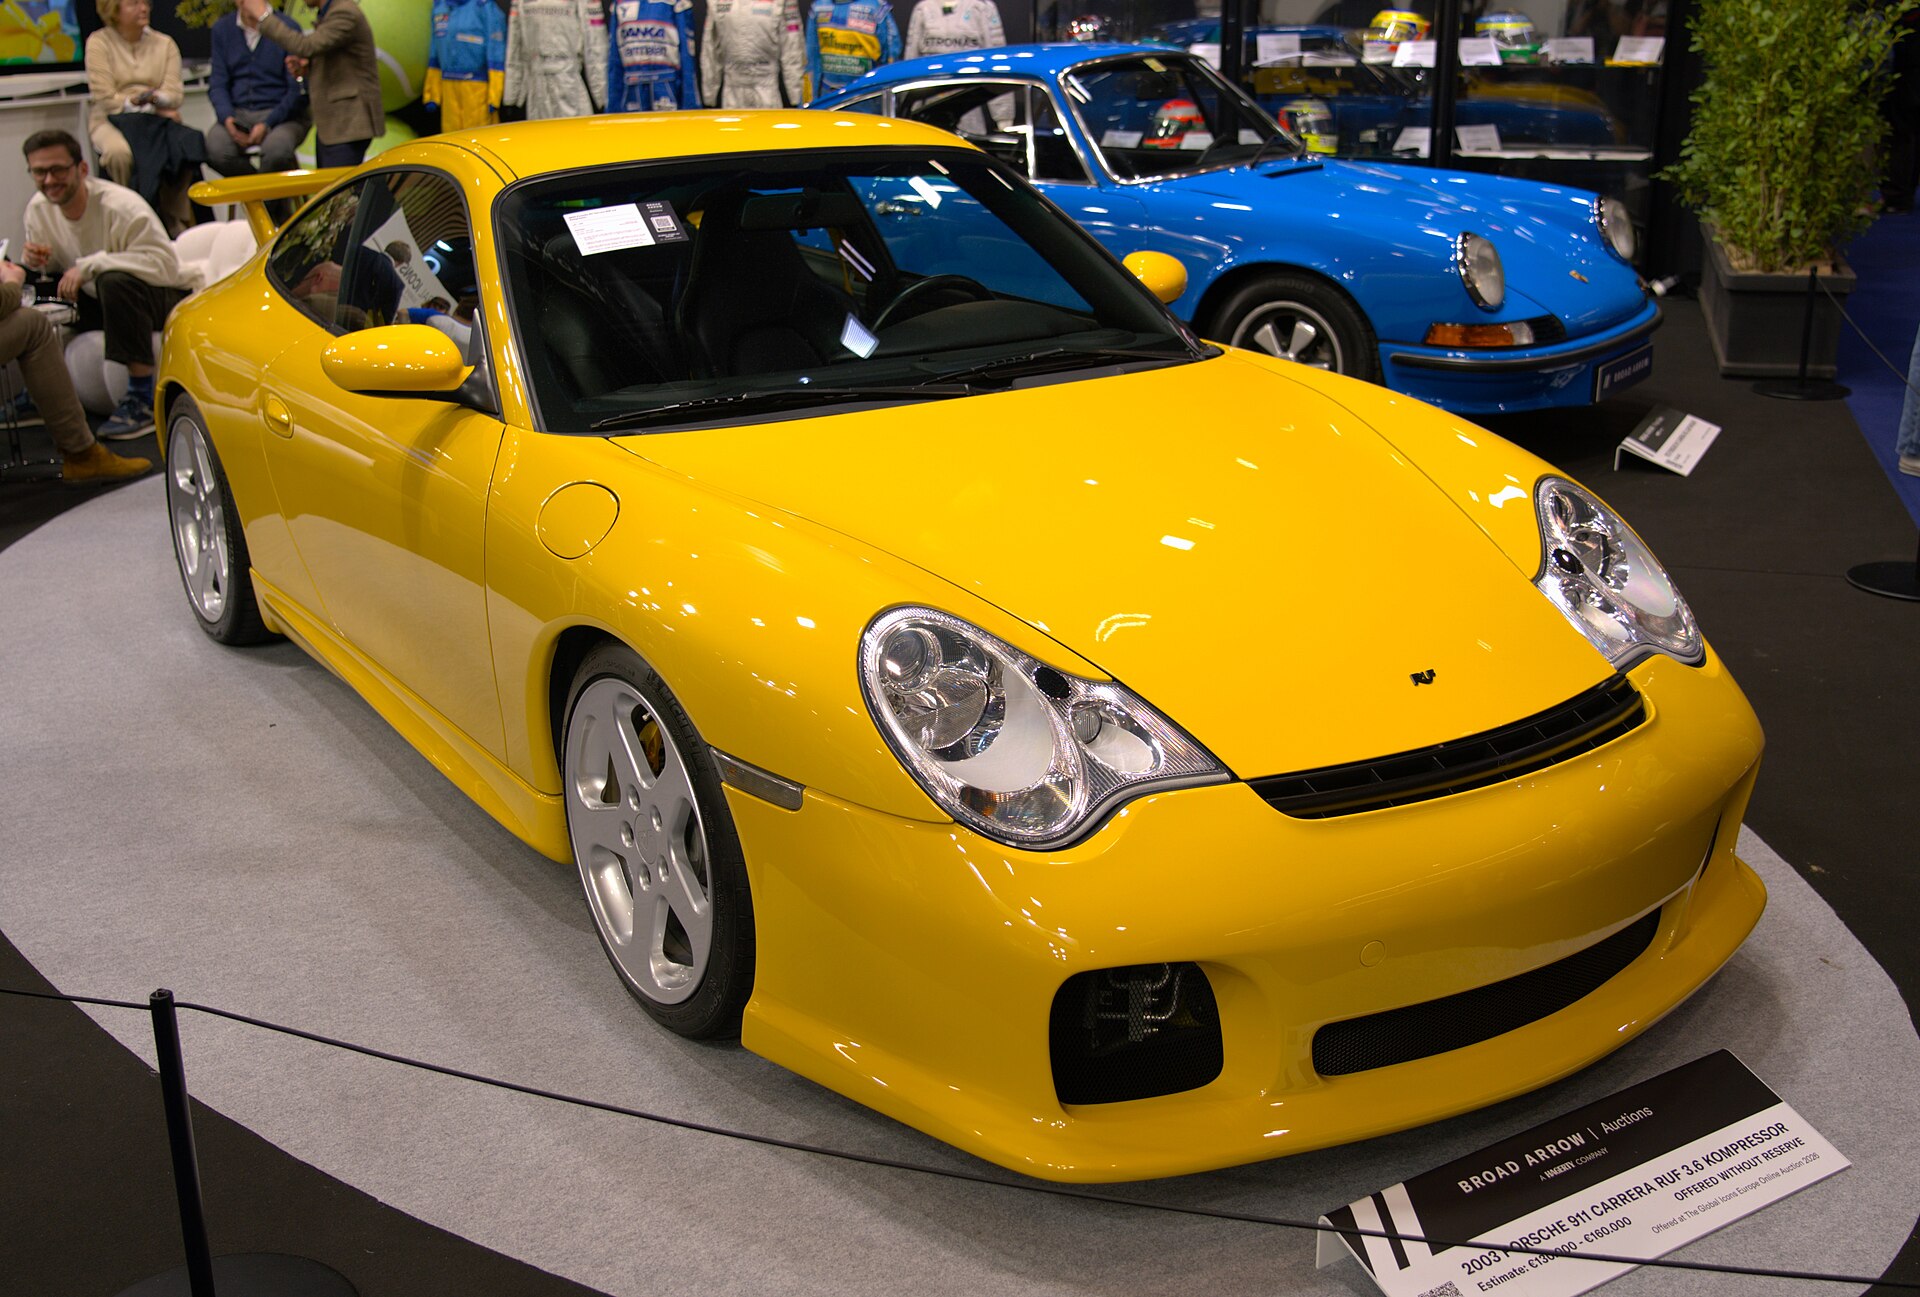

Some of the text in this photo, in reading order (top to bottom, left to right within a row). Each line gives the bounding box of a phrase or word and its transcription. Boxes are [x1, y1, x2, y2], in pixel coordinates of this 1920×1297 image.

[924, 37, 980, 47] ETRONAS
[1457, 1106, 1653, 1194] BROAD ARROW Auctions
[1539, 1147, 1609, 1182] A HAGERTY COMPANY
[1674, 1137, 1805, 1201] OFFERED WITHOUT RESERVE
[1461, 1250, 1502, 1276] 2003
[1567, 1209, 1593, 1228] 911
[1590, 1181, 1657, 1217] CARRERA
[1653, 1168, 1682, 1189] RUF
[1681, 1159, 1705, 1176] 3.6
[1701, 1122, 1789, 1167] KOMPRESSOR
[1651, 1151, 1820, 1234] Offered at The Global Icons Europe Online Auction 2026
[1476, 1263, 1529, 1292] Estimate:
[1583, 1216, 1632, 1243] €160.000
